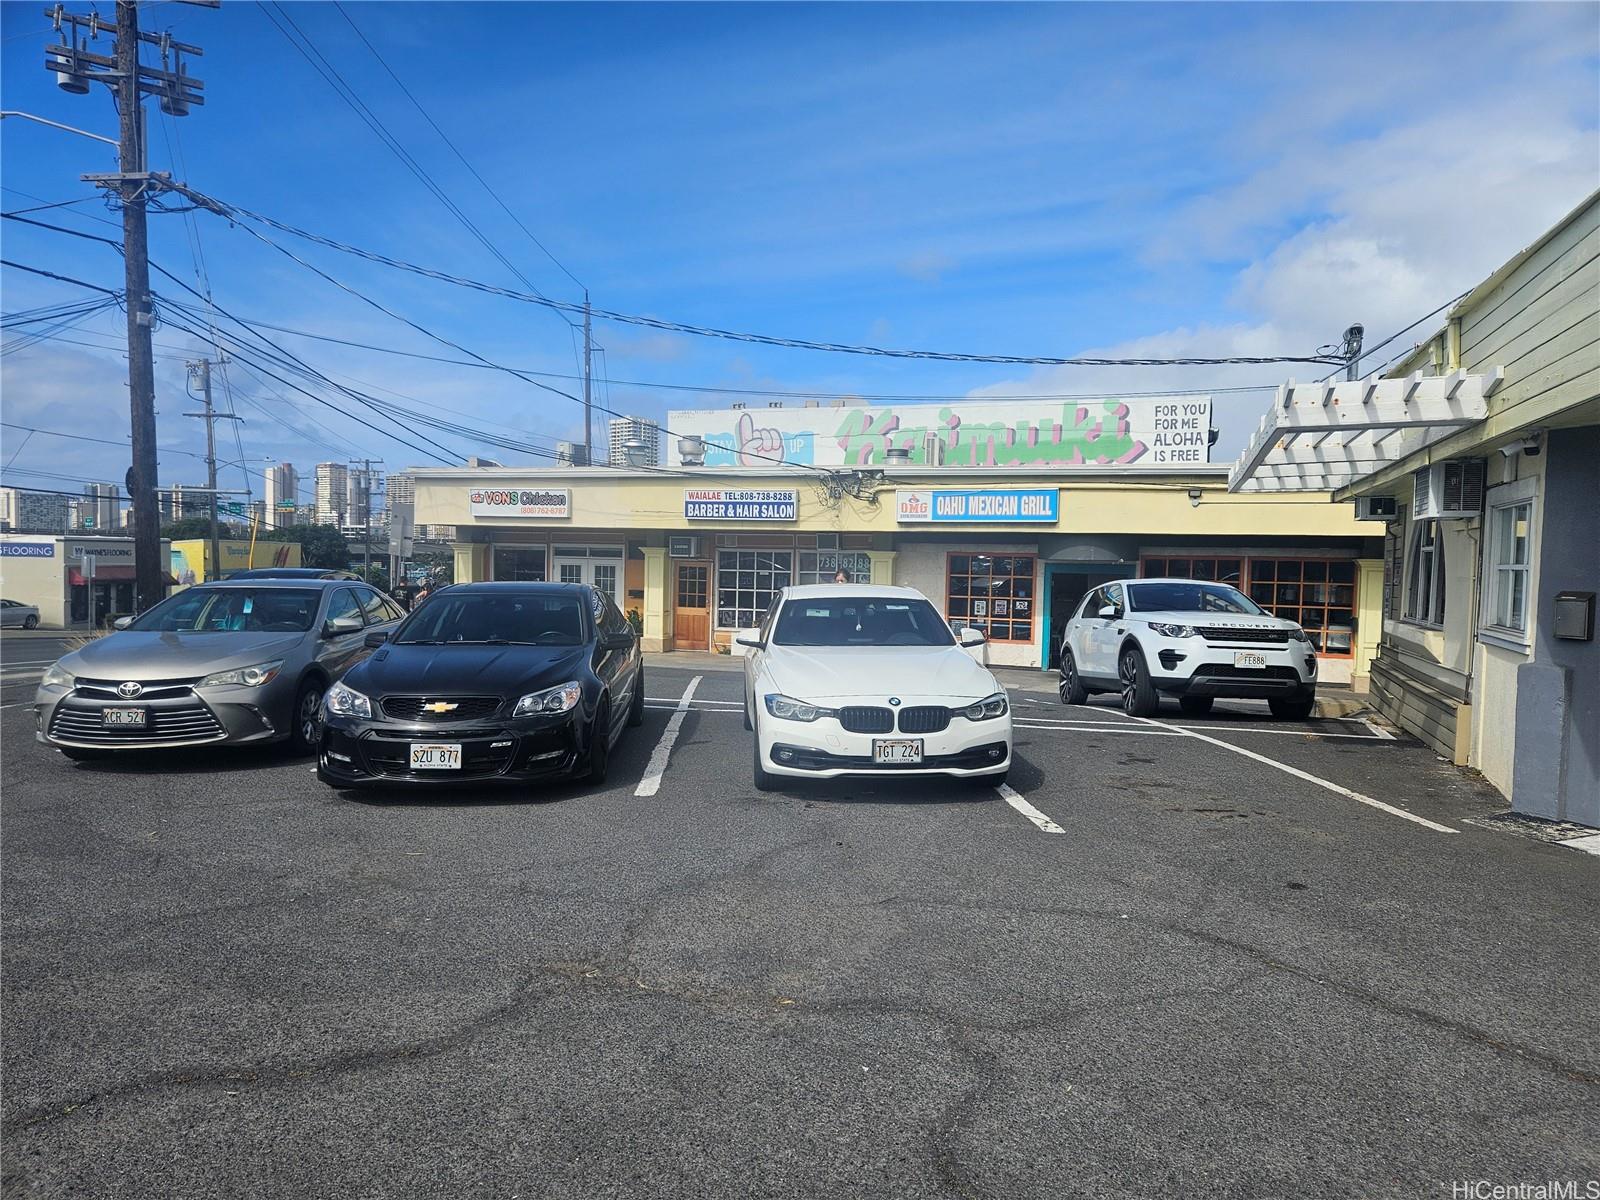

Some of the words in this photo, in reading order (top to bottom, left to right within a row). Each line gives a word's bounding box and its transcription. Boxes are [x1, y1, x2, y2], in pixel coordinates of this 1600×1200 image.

[1155, 405, 1177, 417] FOR
[1182, 404, 1207, 415] YOU
[1155, 419, 1178, 430] FOR
[1182, 418, 1198, 429] ME
[1154, 432, 1204, 446] ALOHA
[790, 439, 804, 454] UP
[1154, 450, 1166, 462] IS
[1171, 449, 1199, 461] FREE
[484, 491, 519, 505] VONS
[519, 491, 567, 506] Chicken
[688, 491, 721, 500] WAIALAE
[724, 492, 793, 501] TEL:808-738-8288
[687, 504, 726, 517] BARBER
[727, 504, 735, 517] &
[736, 504, 760, 518] HAIR
[761, 504, 794, 518] SALON
[900, 502, 928, 513] OMG
[937, 496, 965, 515] OAHU
[968, 496, 1018, 515] MEXICAN
[1020, 495, 1052, 515] GRILL
[2, 547, 53, 556] FLOORING
[1244, 656, 1265, 665] FE888
[104, 711, 122, 720] KCR
[127, 711, 145, 720] 527
[413, 750, 433, 763] SZU
[439, 750, 459, 763] 877
[877, 745, 895, 758] TGT
[901, 745, 920, 758] 224
